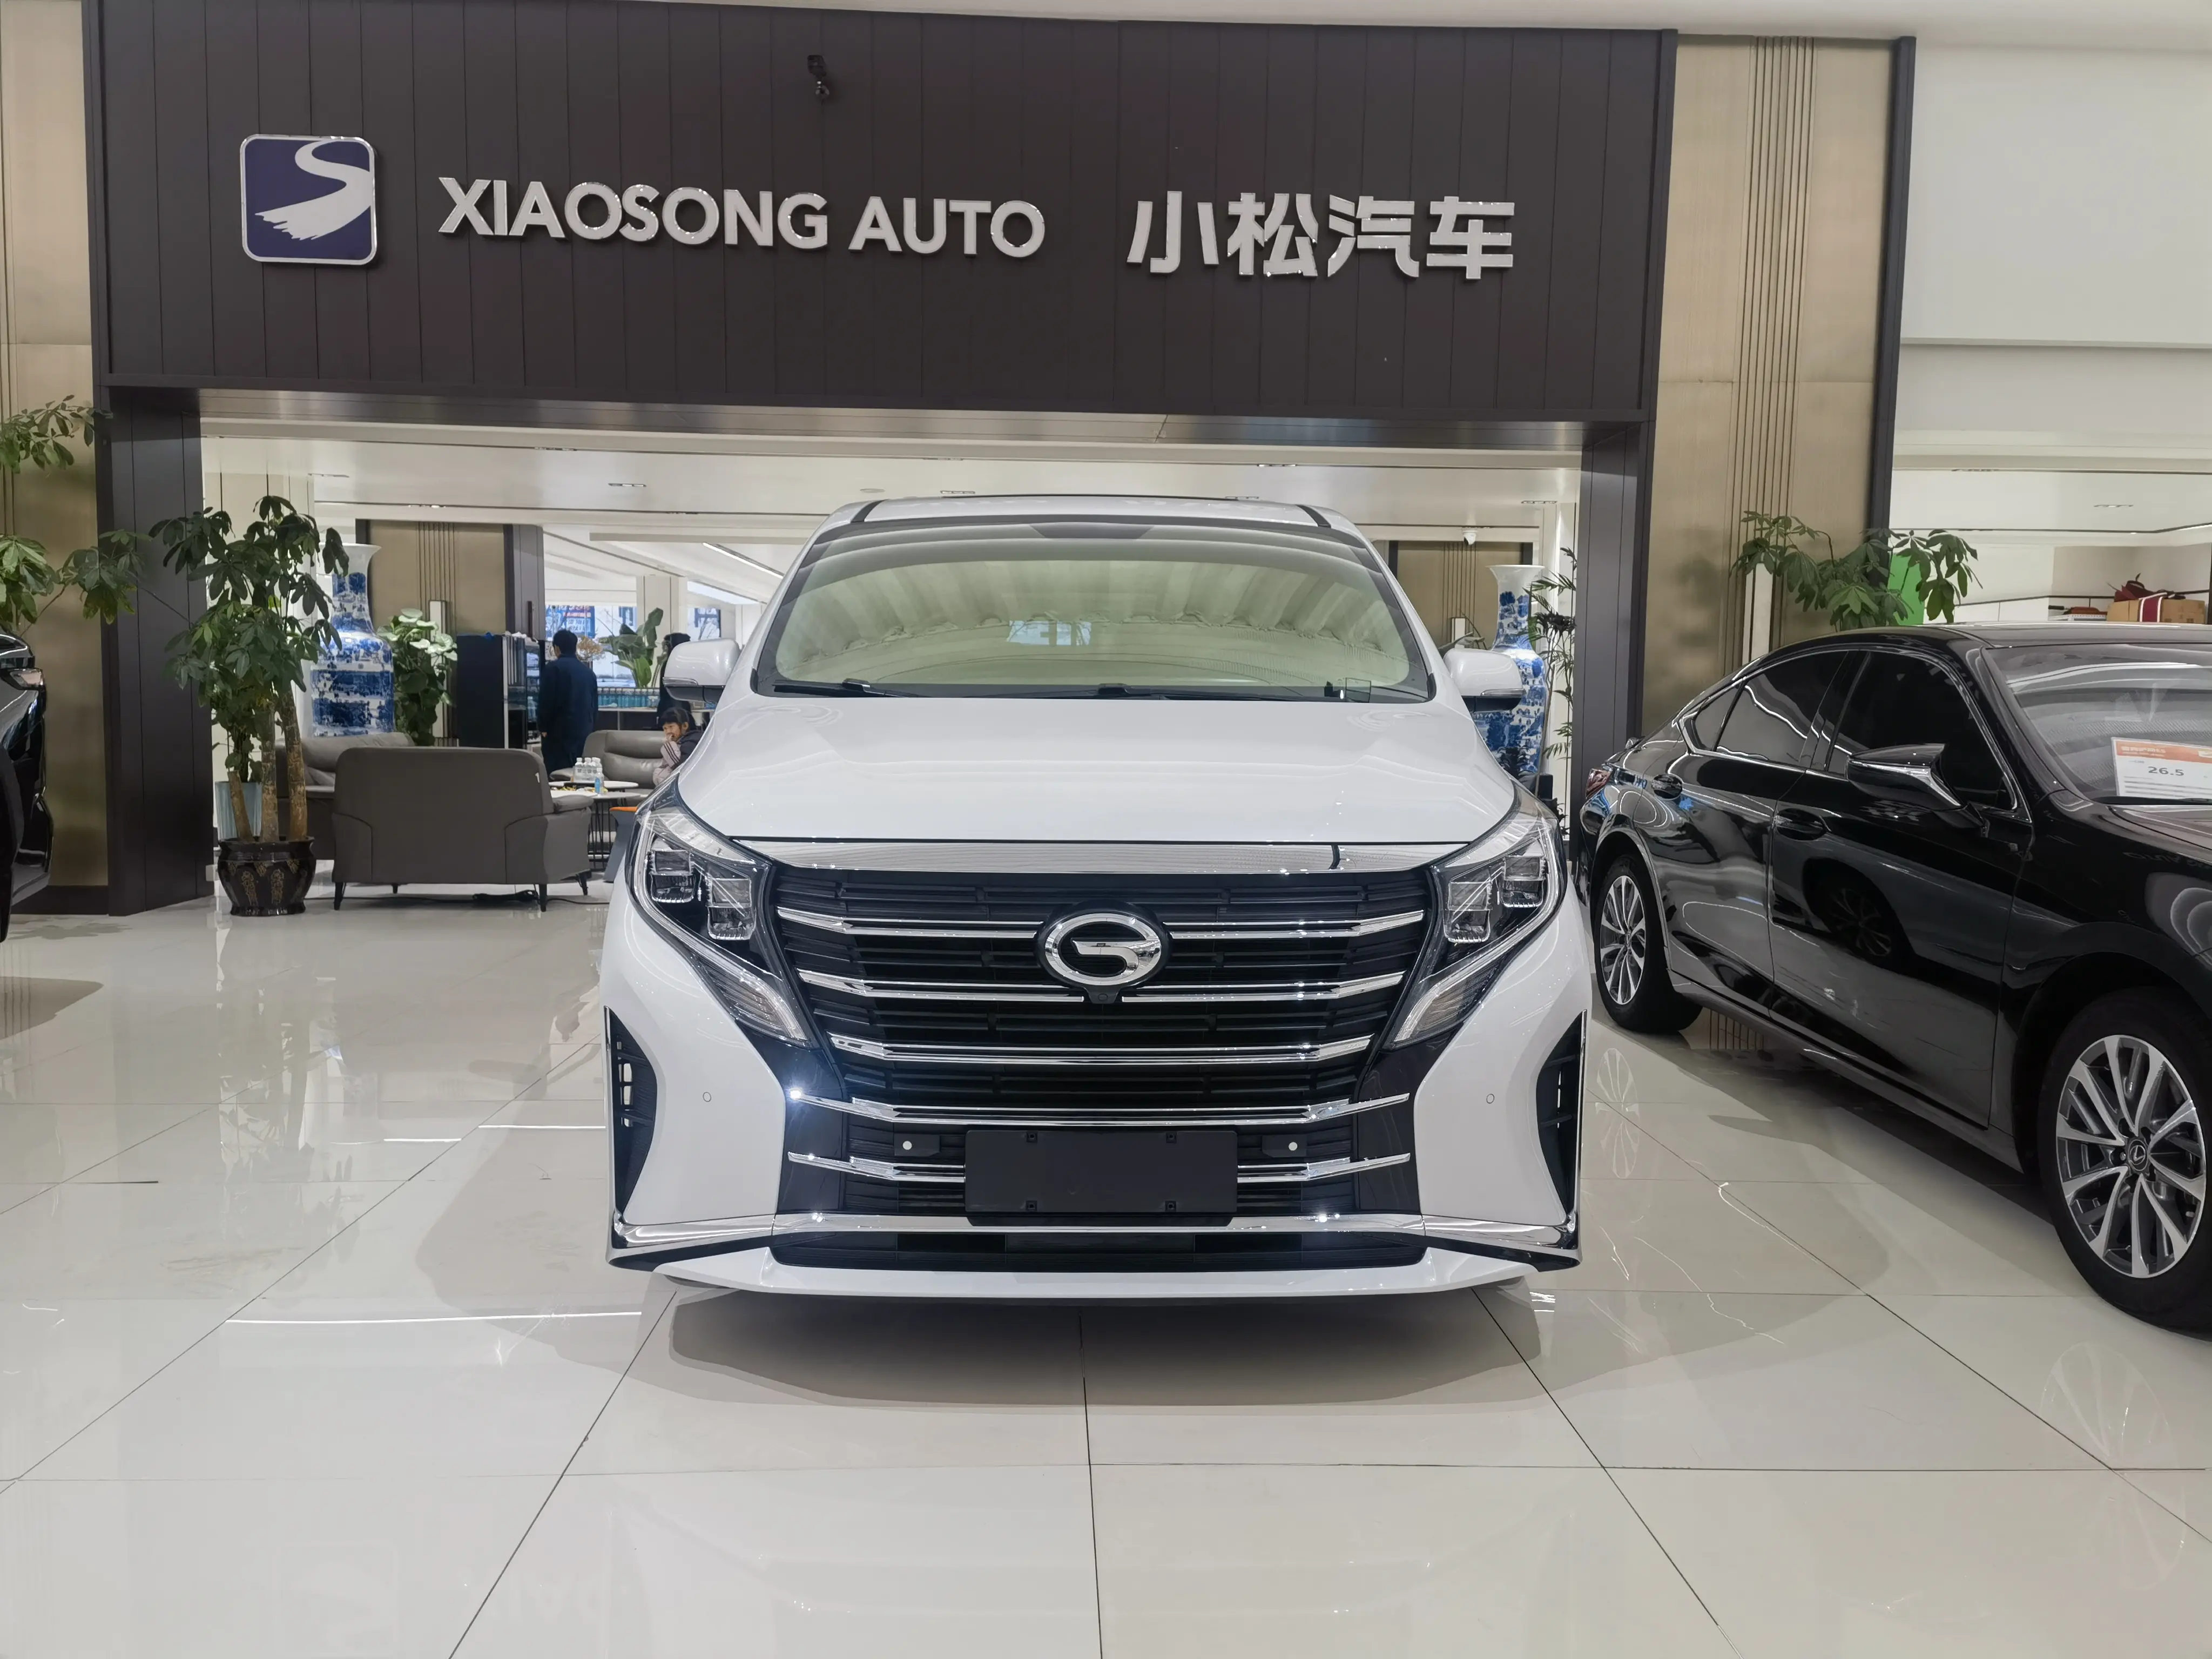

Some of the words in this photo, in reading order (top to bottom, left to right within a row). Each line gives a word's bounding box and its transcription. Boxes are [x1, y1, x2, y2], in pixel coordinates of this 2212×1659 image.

[439, 176, 828, 249] XIAOSONG
[849, 196, 1045, 258] AUTO
[1127, 191, 1514, 279] 小松汽车
[2148, 766, 2184, 776] 26.5
